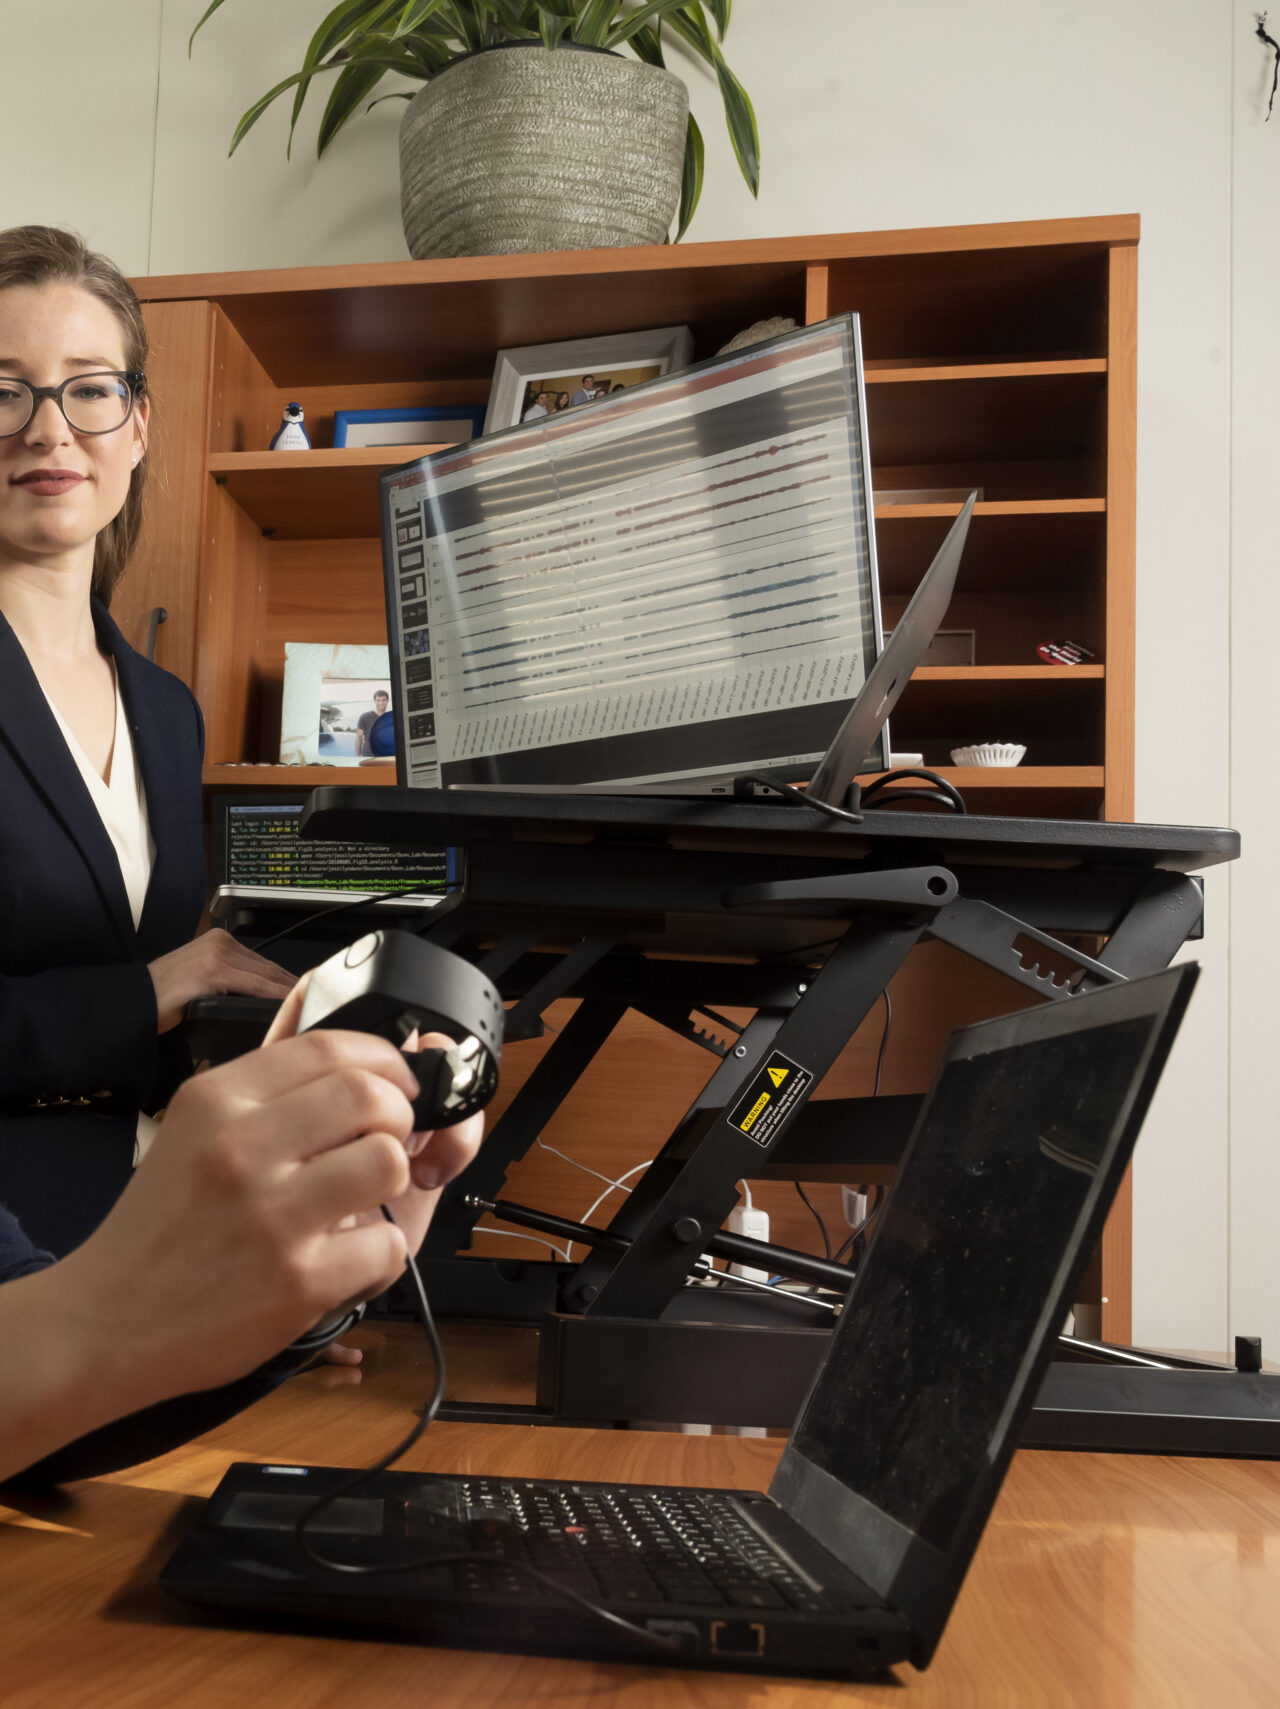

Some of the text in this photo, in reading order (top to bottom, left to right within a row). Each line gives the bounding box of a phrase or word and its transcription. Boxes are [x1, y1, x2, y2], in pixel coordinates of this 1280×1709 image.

[743, 1095, 768, 1128] WARNING
[750, 1104, 774, 1136] Avoid Pinching!
[755, 1131, 762, 1140] DO
[759, 1122, 769, 1133] NOT
[766, 1115, 774, 1124] put
[771, 1105, 781, 1117] your
[777, 1093, 789, 1107] hands
[786, 1082, 796, 1094] close
[796, 1070, 804, 1078] the
[760, 1124, 775, 1143] structure
[772, 1112, 782, 1125] when
[779, 1101, 791, 1114] lifting
[787, 1094, 795, 1102] the
